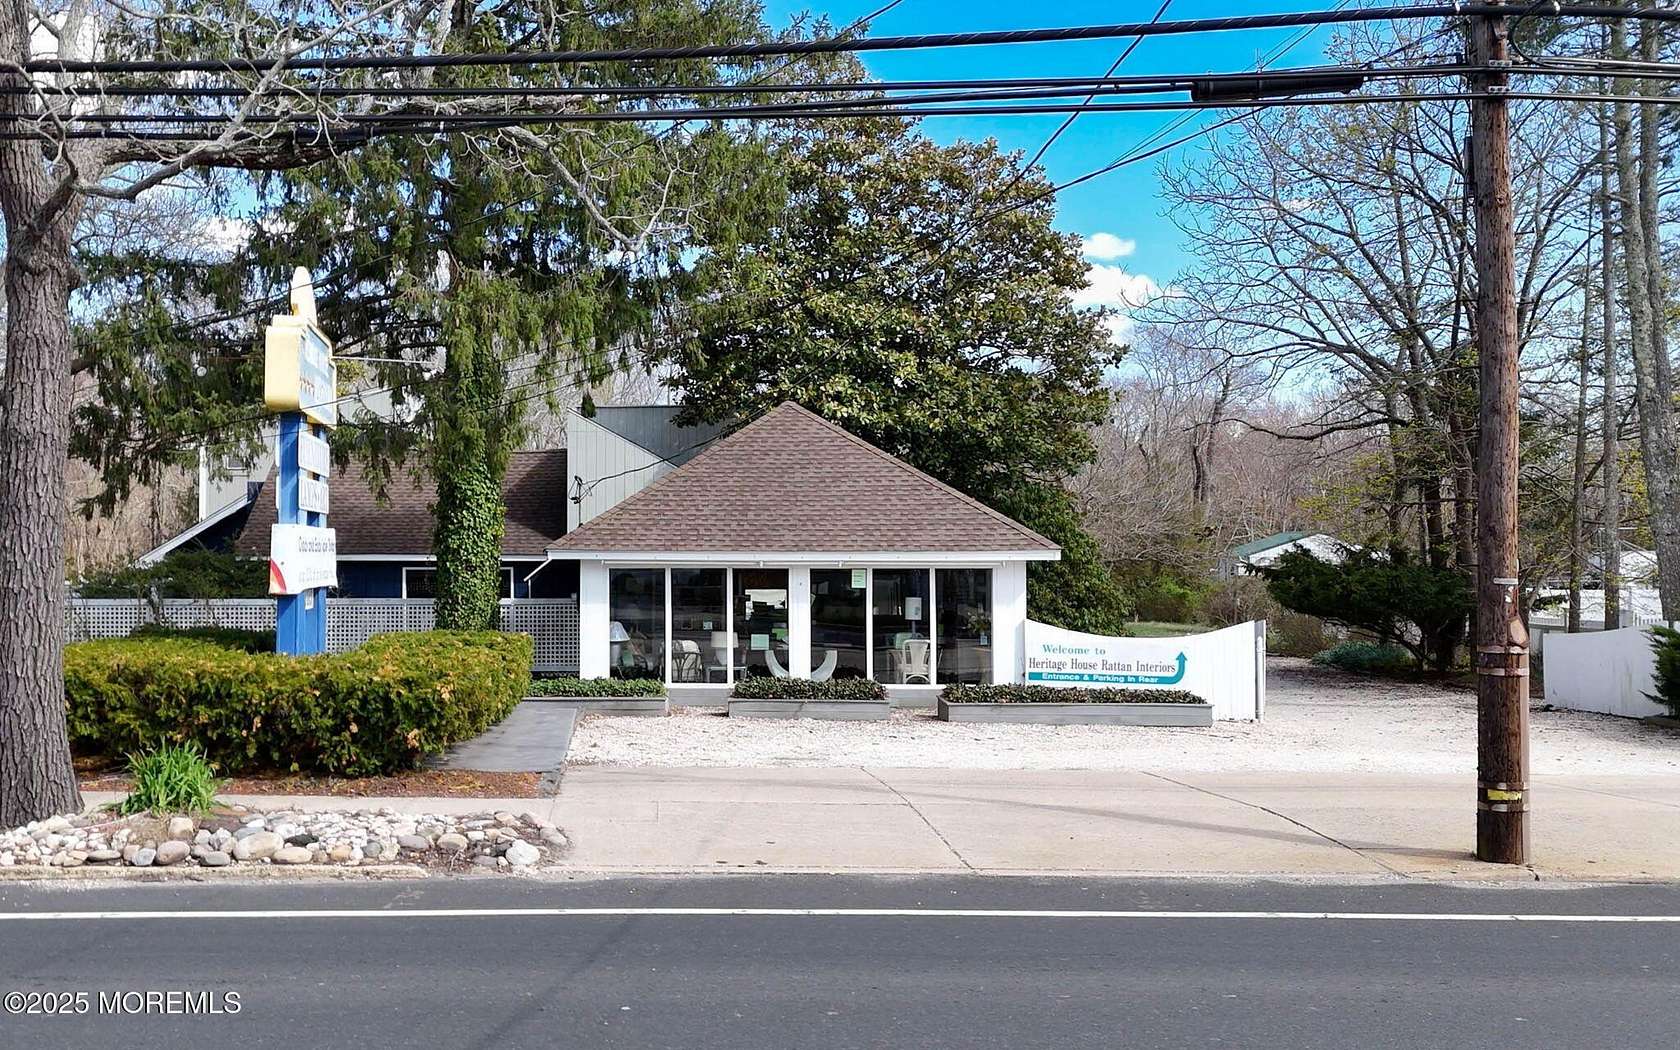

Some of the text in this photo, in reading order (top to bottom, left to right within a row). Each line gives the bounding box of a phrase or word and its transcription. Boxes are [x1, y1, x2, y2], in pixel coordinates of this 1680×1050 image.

[1042, 644, 1106, 655] Welcome to
[1029, 657, 1176, 673] Heritage House Rattan Interiors
[1042, 672, 1080, 681] Entrance
[1083, 673, 1090, 681] &
[1093, 674, 1125, 683] Parking
